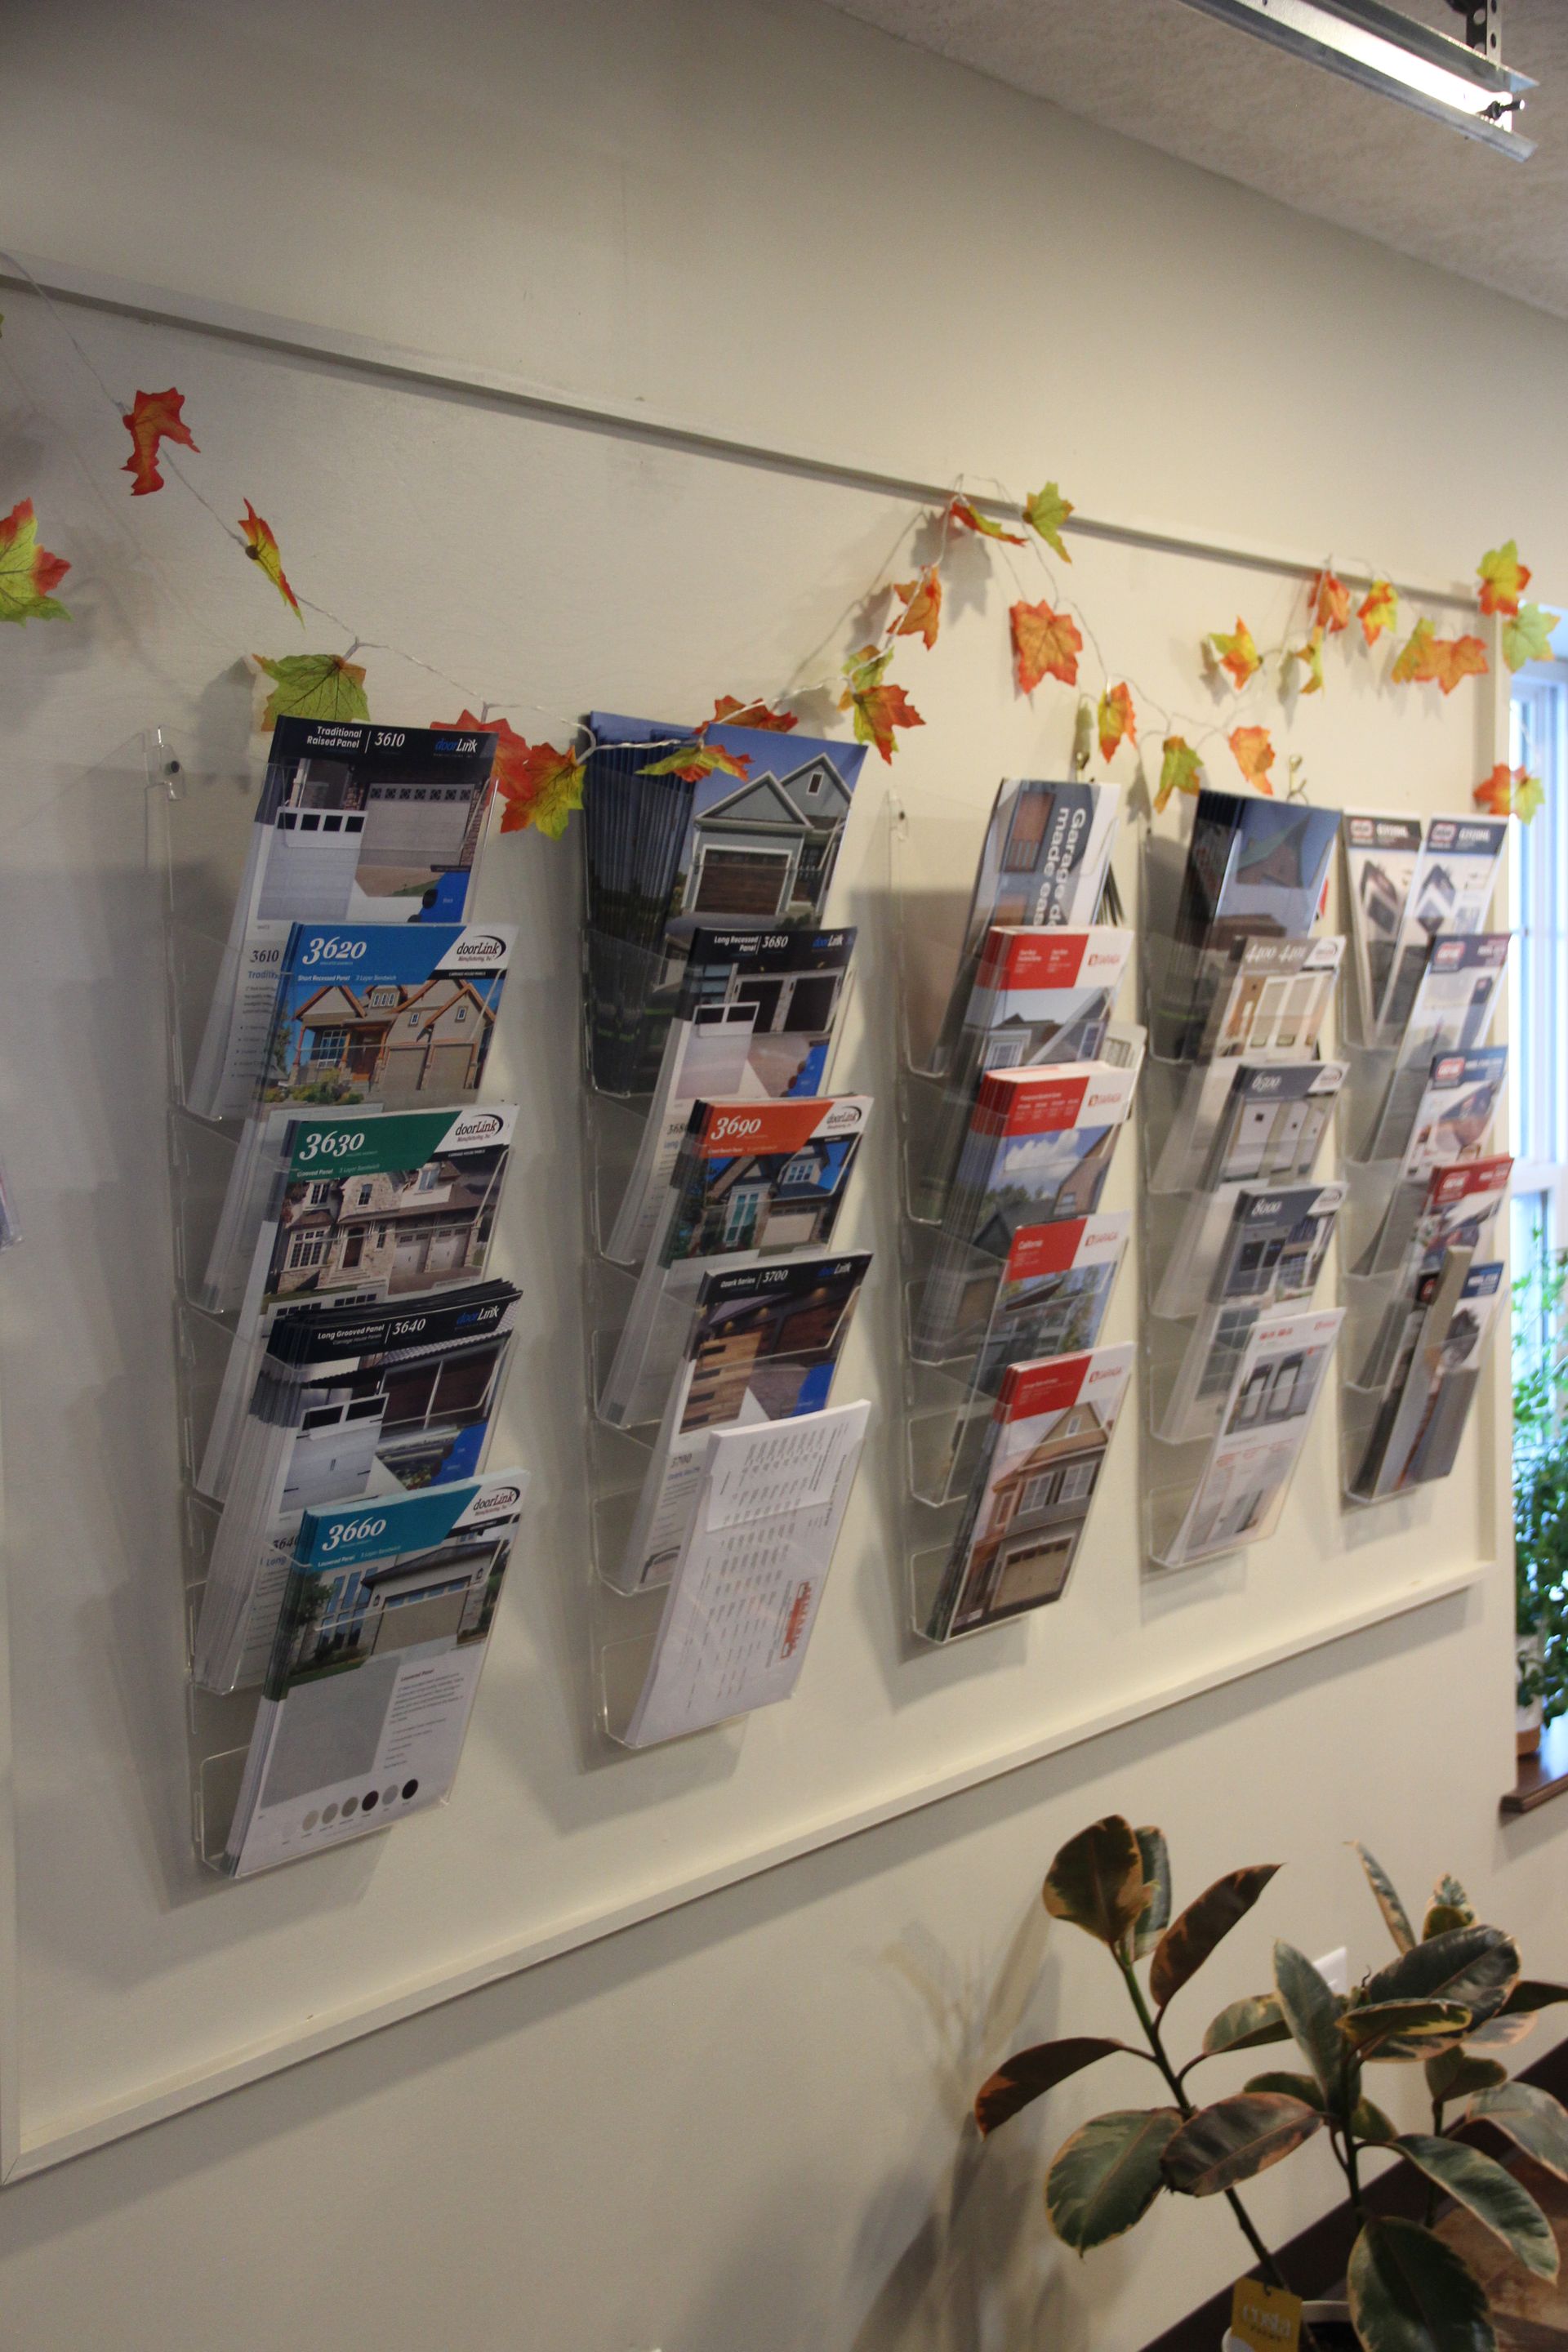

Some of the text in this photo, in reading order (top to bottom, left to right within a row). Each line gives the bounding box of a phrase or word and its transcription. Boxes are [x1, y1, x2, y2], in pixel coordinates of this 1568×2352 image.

[306, 735, 360, 748] Raised Panel
[317, 725, 405, 747] Traditional 3610
[1044, 808, 1071, 876] made
[1054, 808, 1086, 899] Garage
[302, 936, 368, 965] 3620
[456, 942, 501, 955] doorLink
[762, 935, 789, 948] 3680
[250, 949, 279, 963] 3610
[455, 1120, 497, 1136] doorLink
[710, 1115, 762, 1140] 3690
[299, 1130, 365, 1160] 3630
[763, 1269, 789, 1283] 3700
[318, 1317, 426, 1342] Long Grooved Panel 3640
[473, 1491, 514, 1511] doorLink
[322, 1517, 387, 1552] 3660
